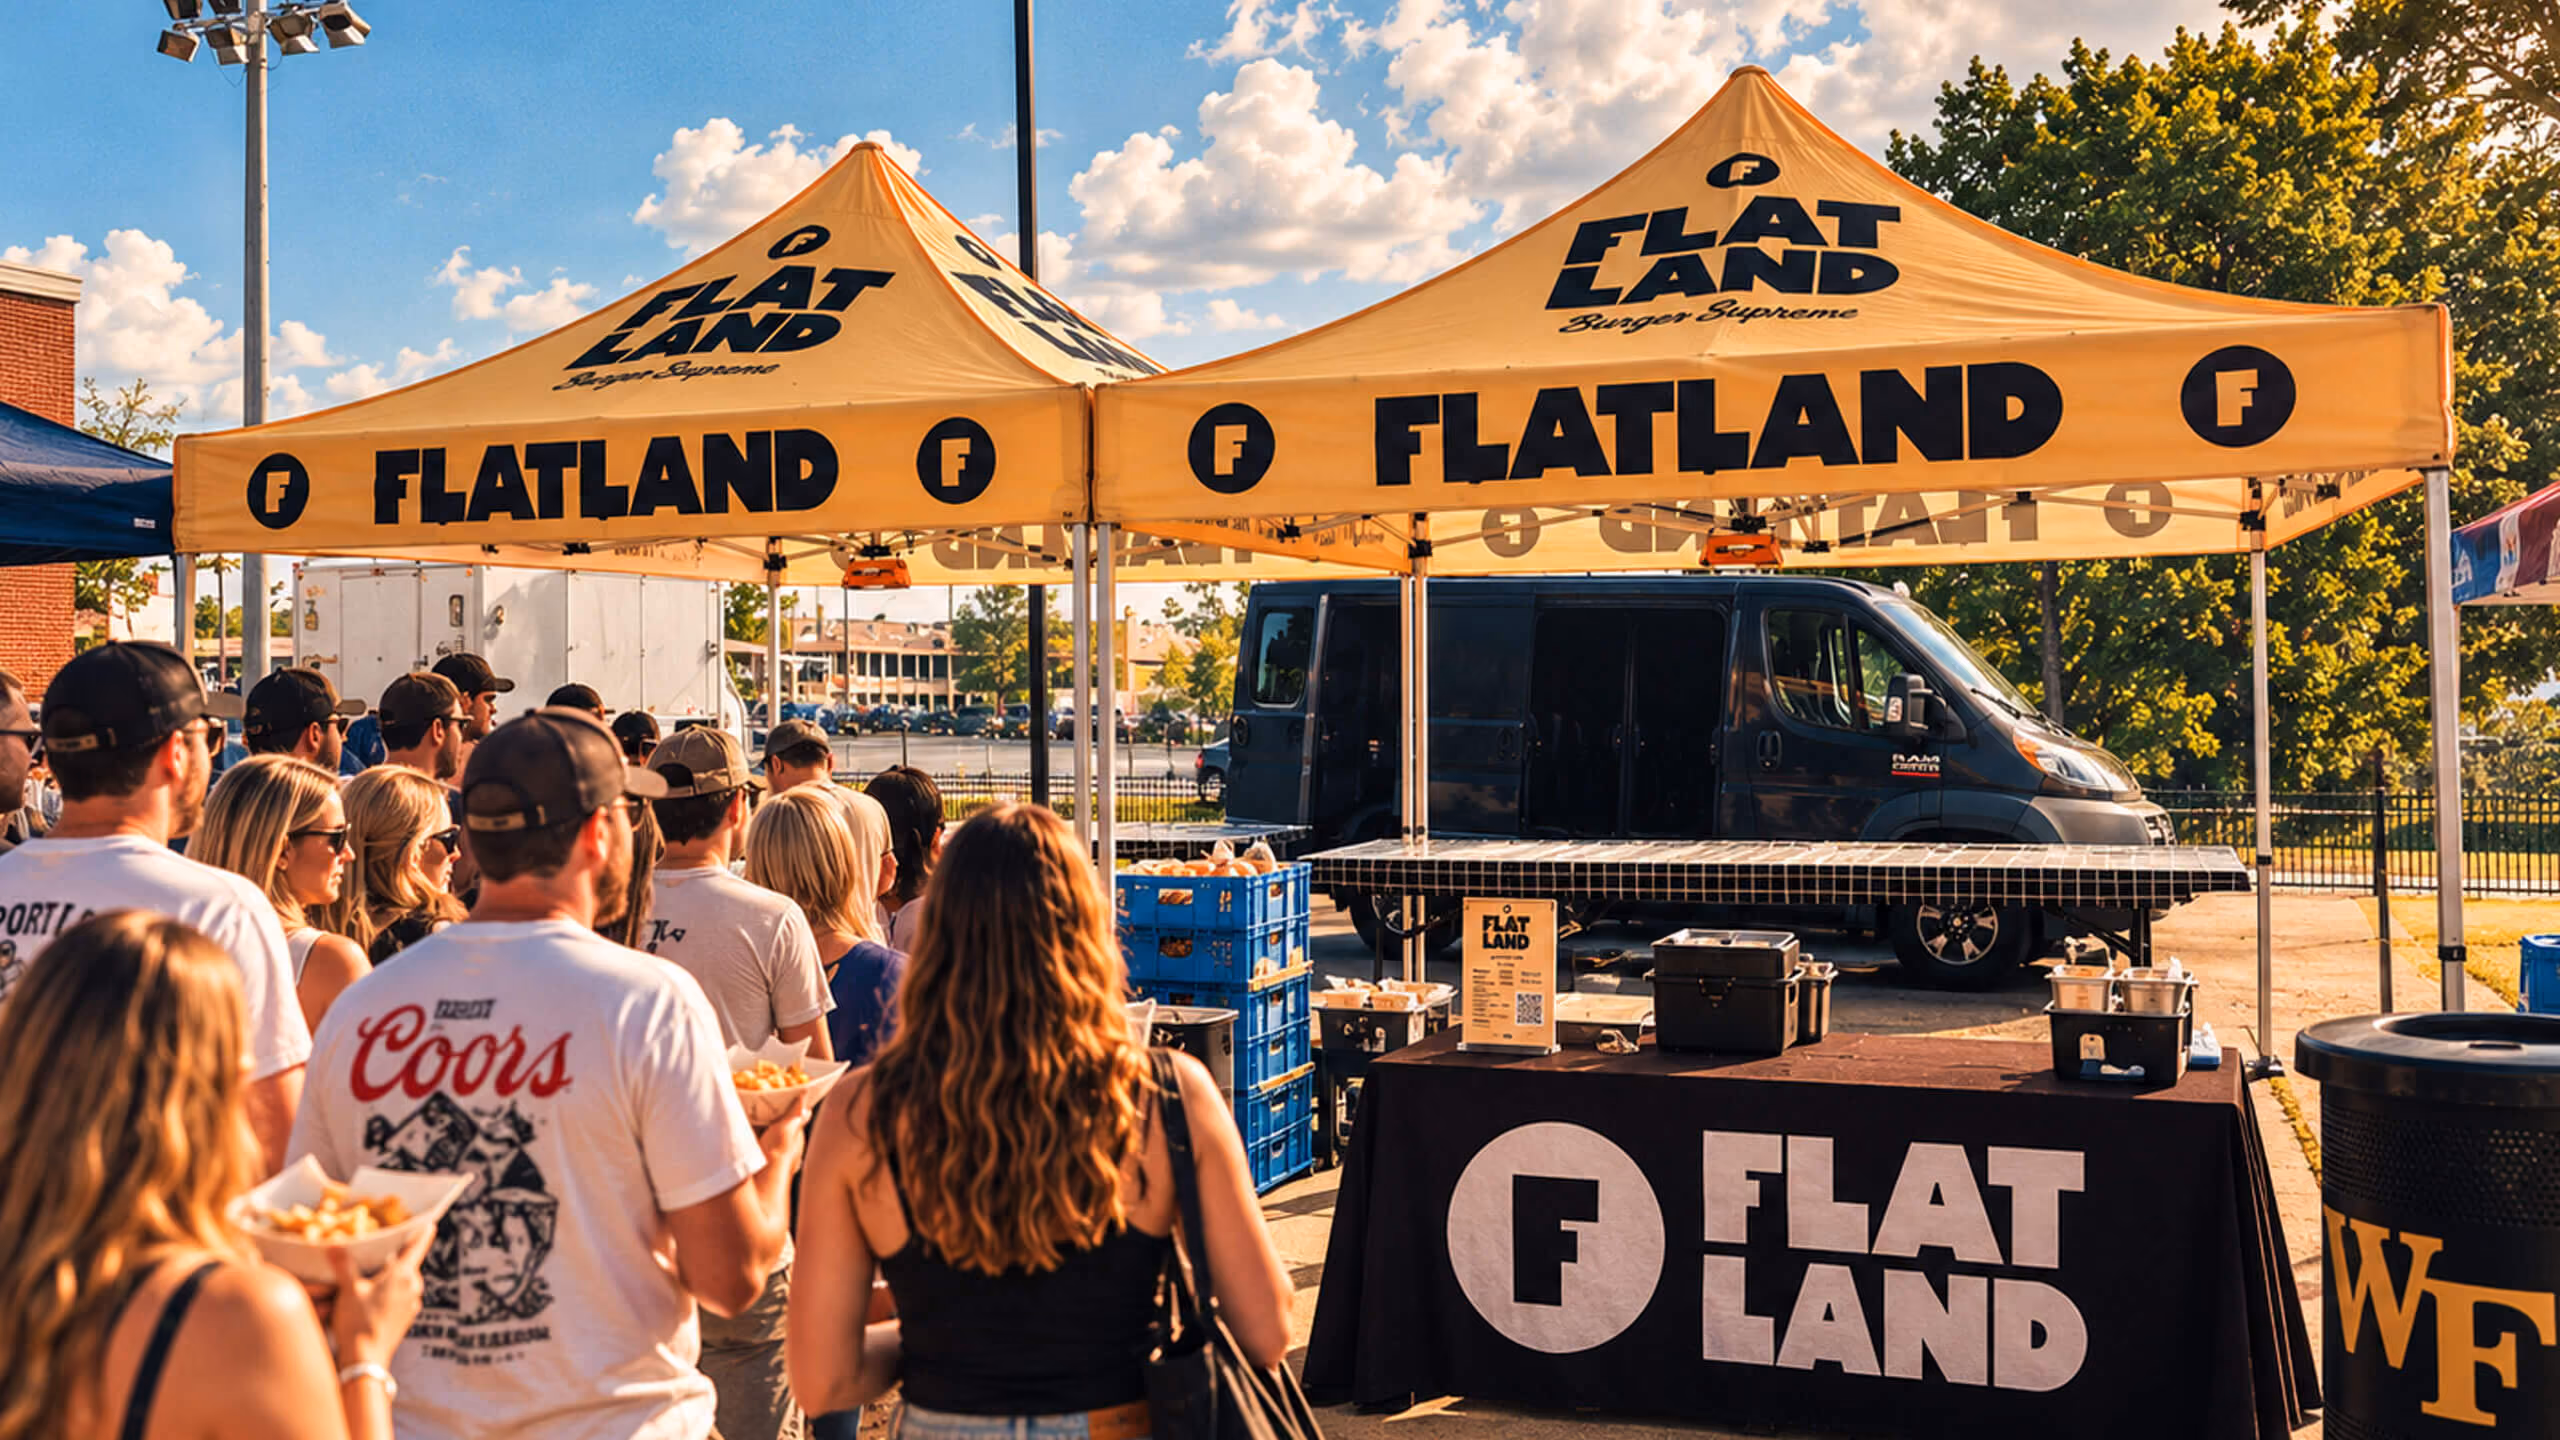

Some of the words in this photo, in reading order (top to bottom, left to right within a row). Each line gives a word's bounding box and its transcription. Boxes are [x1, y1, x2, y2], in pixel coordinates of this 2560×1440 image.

[1564, 195, 1901, 265] FLAT
[613, 265, 896, 331] FLAT
[1545, 246, 1900, 310] LAND
[563, 312, 842, 371] LAND
[1558, 311, 1692, 334] Burger
[1696, 299, 1859, 323] Supreme
[552, 371, 654, 391] Burger
[652, 361, 780, 381] Supreme
[1376, 362, 2064, 487] FLATLAND
[374, 428, 840, 524] FLATLAND
[1482, 915, 1530, 932] FLAT
[1482, 933, 1530, 950] LAND
[350, 1004, 573, 1102] Coors
[1703, 1130, 2085, 1269] FLAT
[1703, 1254, 2088, 1392] LAND
[2323, 1203, 2557, 1427] WF
